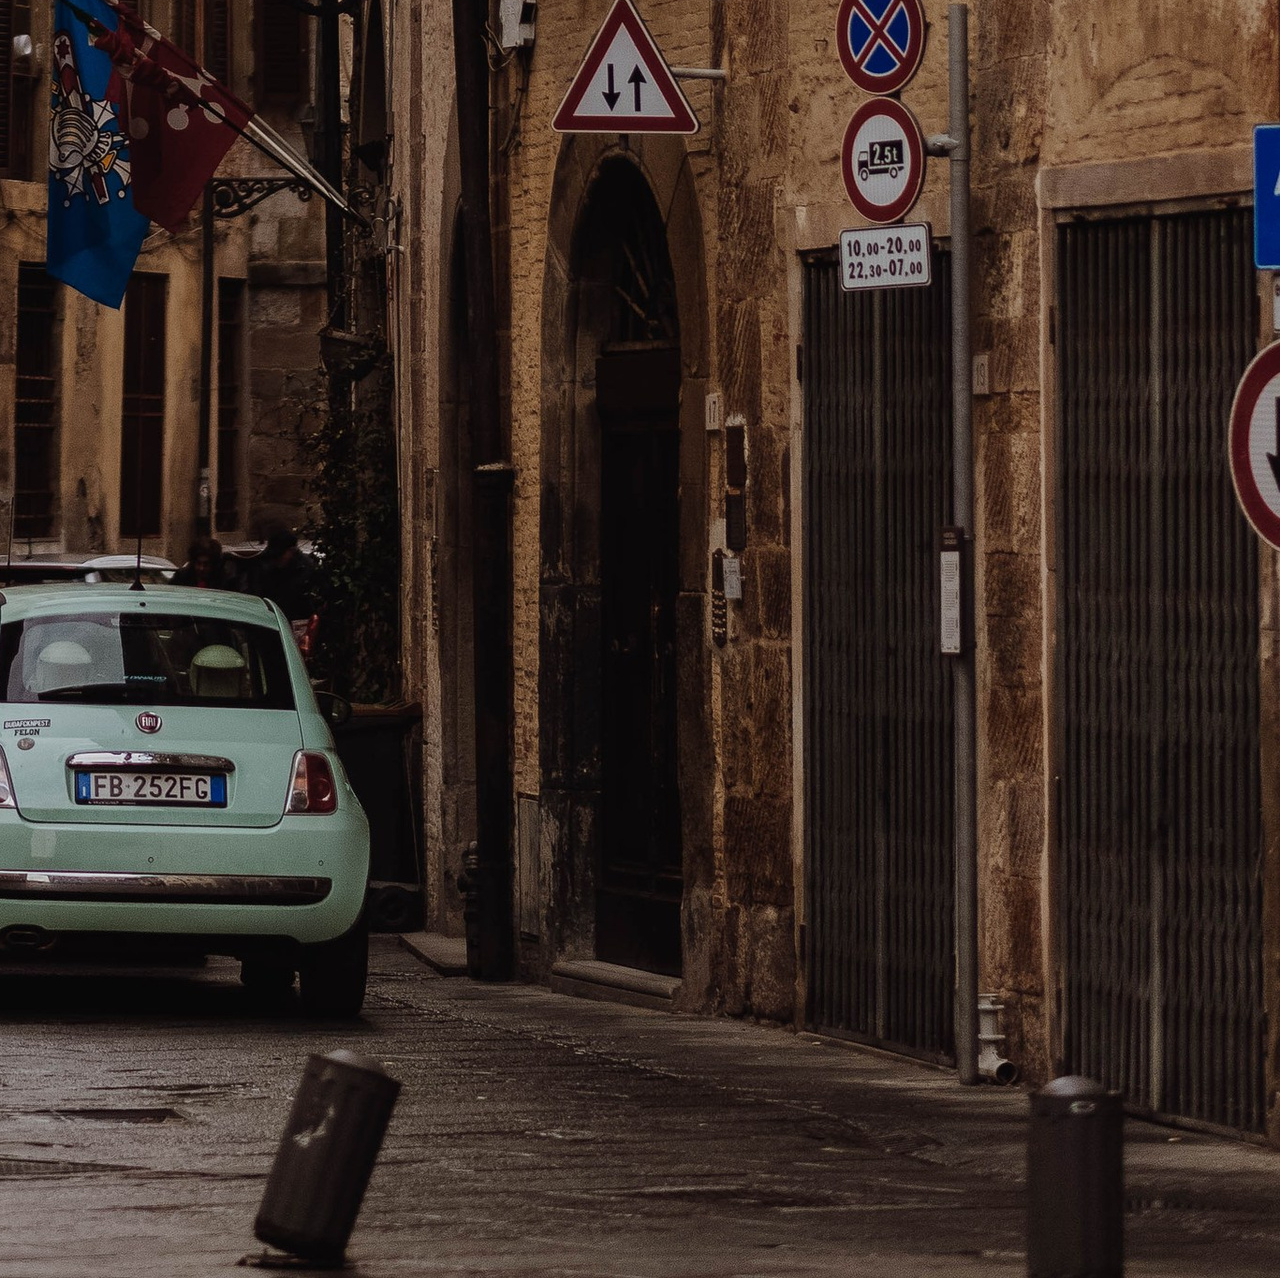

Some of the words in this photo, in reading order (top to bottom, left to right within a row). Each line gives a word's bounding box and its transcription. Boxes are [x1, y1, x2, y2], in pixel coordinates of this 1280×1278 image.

[141, 716, 156, 727] FIAT
[14, 728, 40, 736] FELON
[133, 775, 208, 800] 252FG
